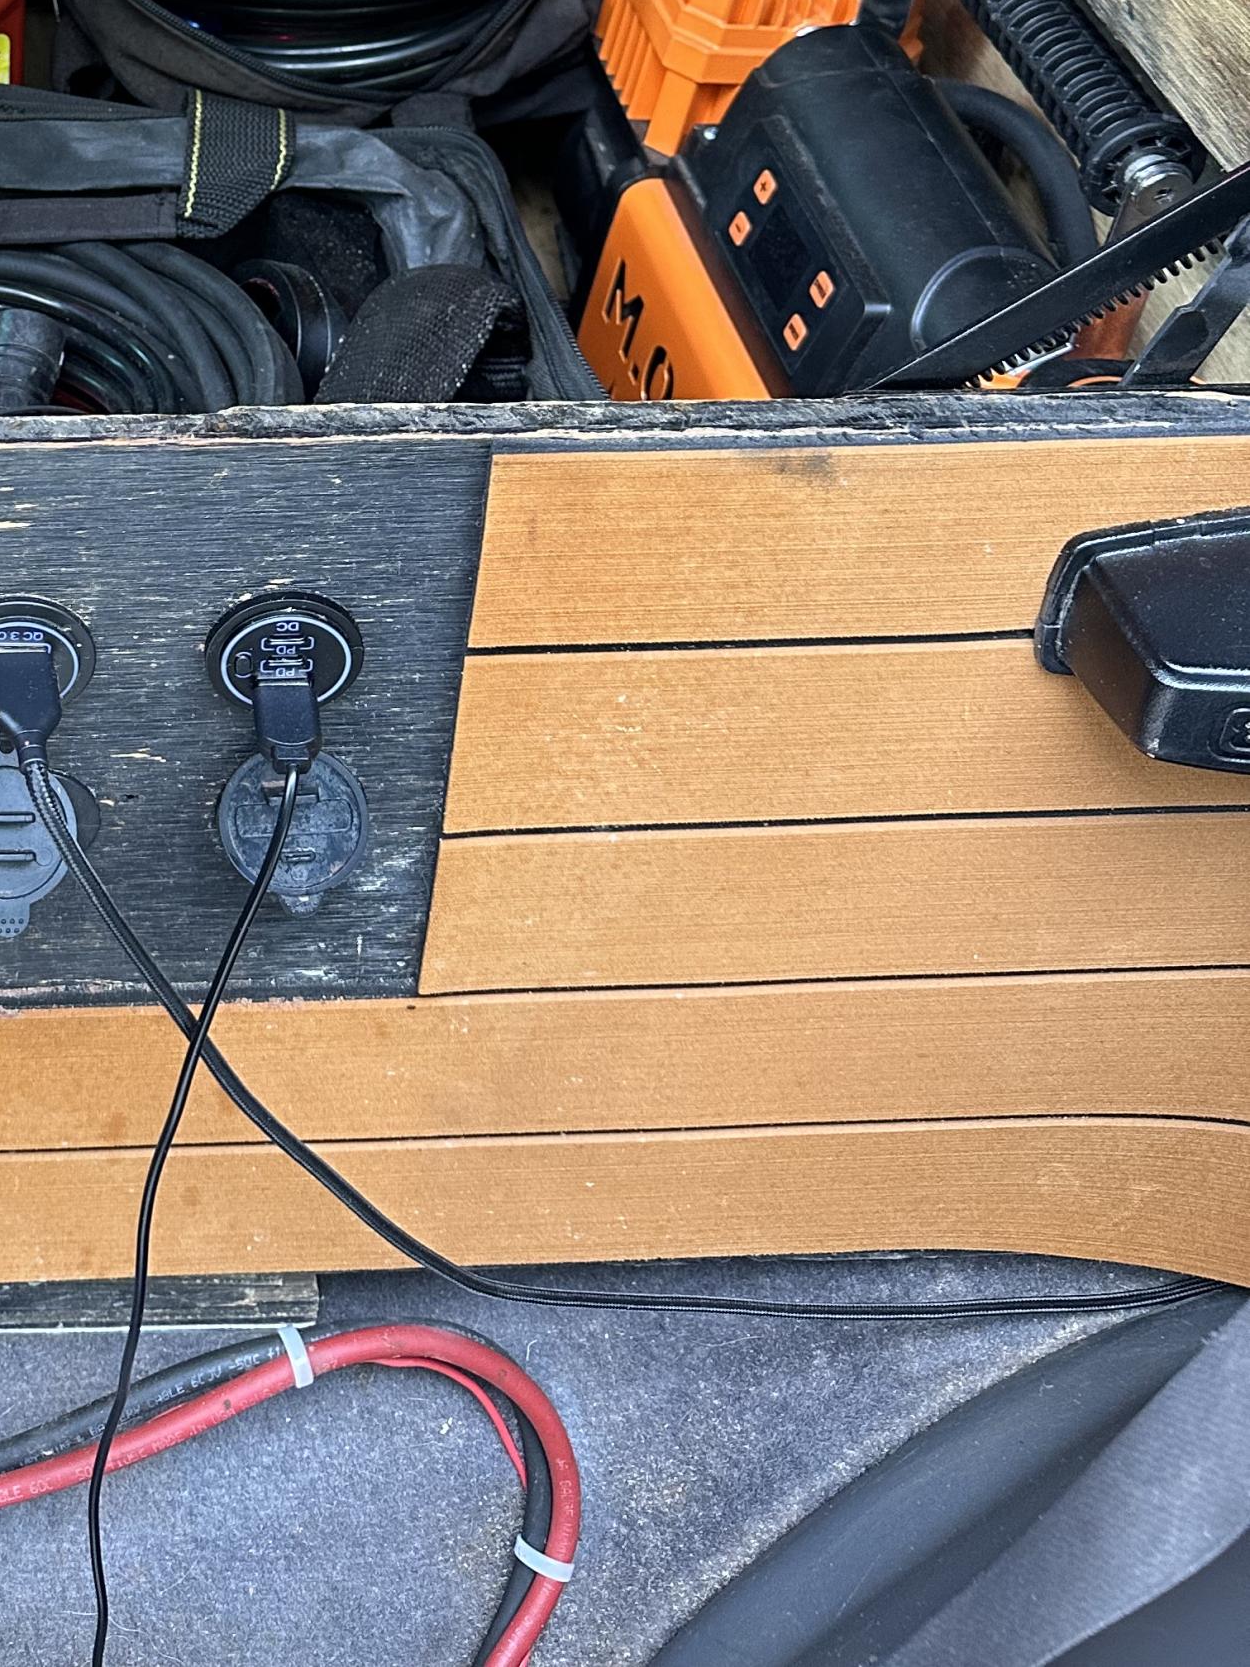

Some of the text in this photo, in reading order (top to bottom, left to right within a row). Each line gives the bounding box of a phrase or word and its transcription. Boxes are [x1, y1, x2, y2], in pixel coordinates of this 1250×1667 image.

[276, 622, 300, 632] DC
[22, 631, 45, 642] QC
[276, 645, 297, 655] PD
[275, 667, 296, 677] PD
